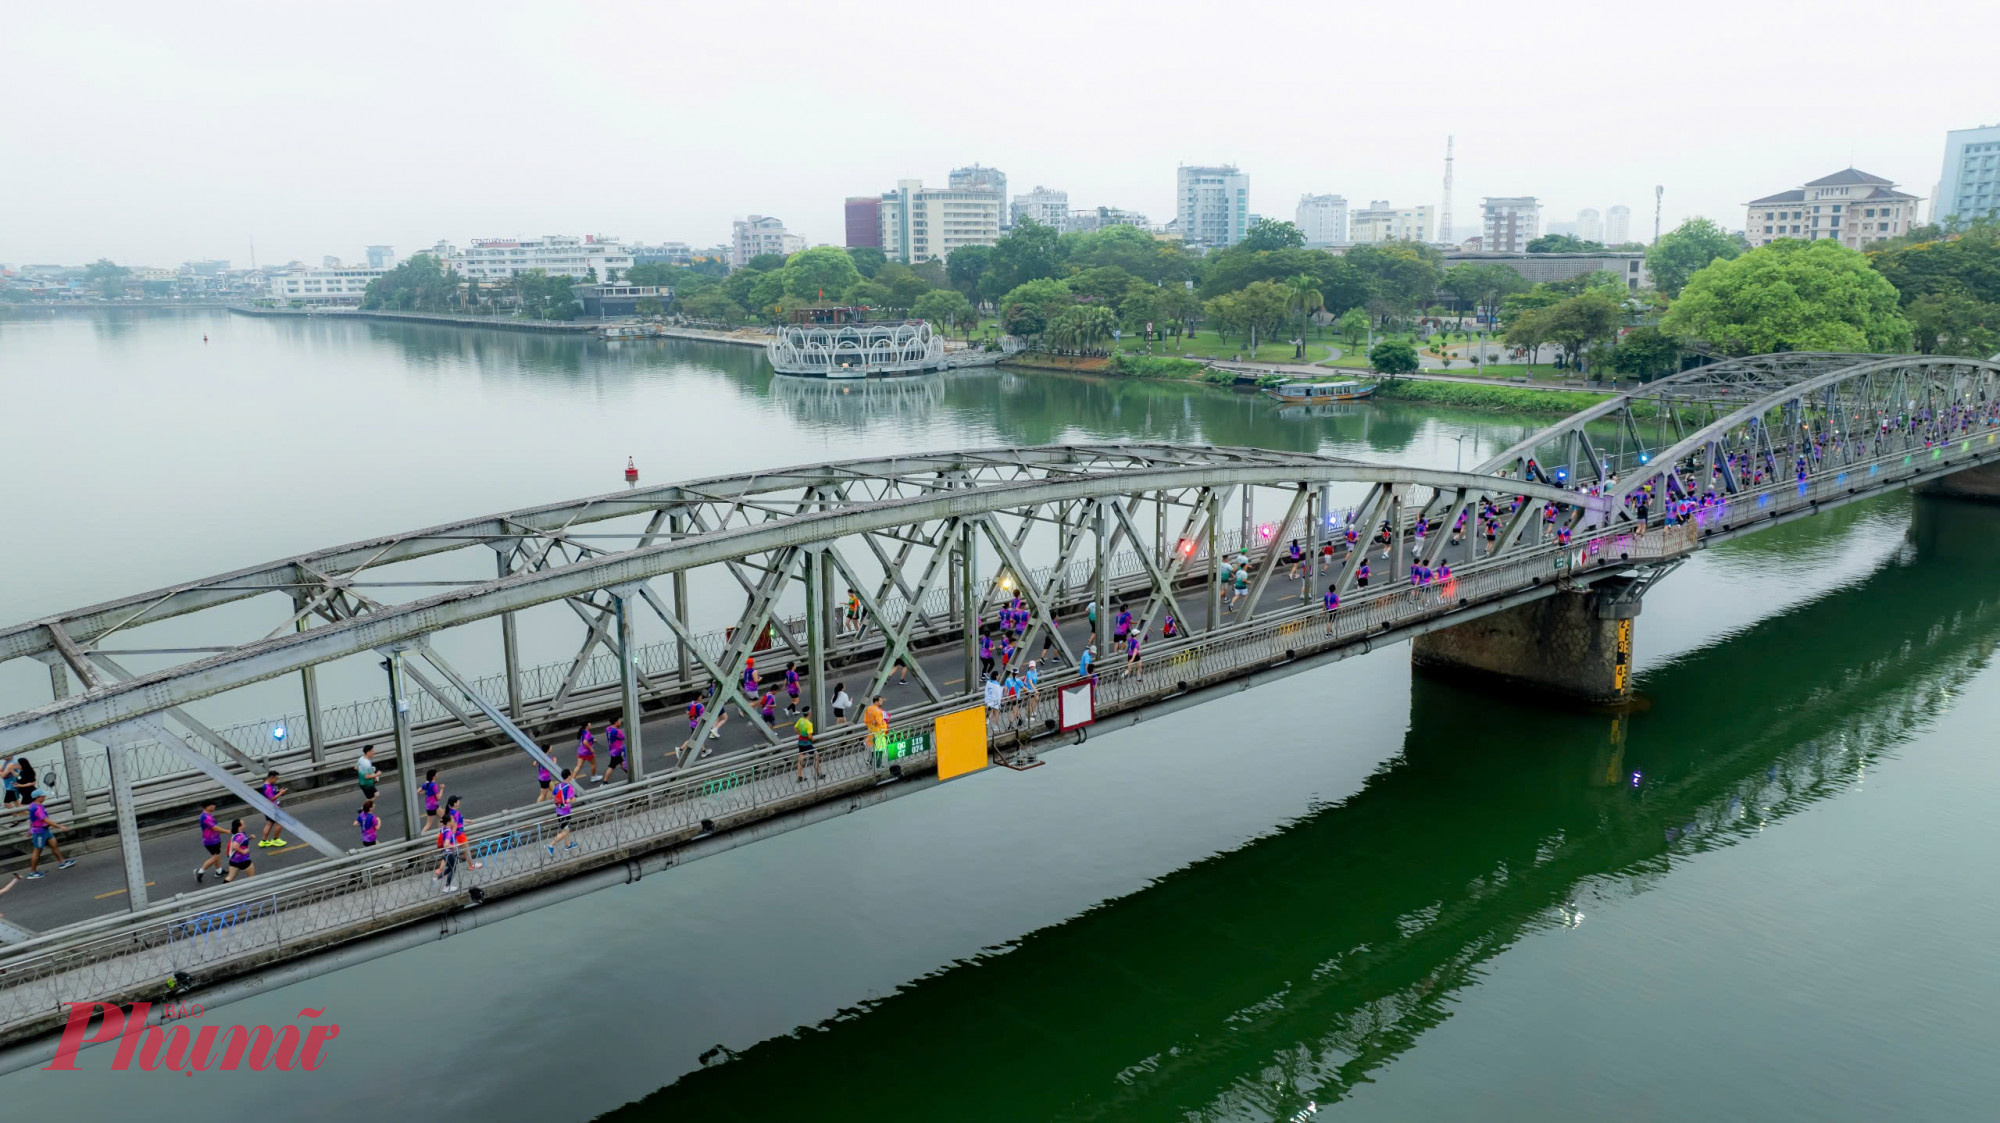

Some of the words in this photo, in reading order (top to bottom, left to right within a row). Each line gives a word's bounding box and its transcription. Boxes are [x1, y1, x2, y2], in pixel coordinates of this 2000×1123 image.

[470, 237, 502, 245] CENTURY
[1618, 642, 1625, 653] 3
[1617, 666, 1623, 676] 4
[911, 736, 923, 745] 119
[897, 749, 906, 758] CT
